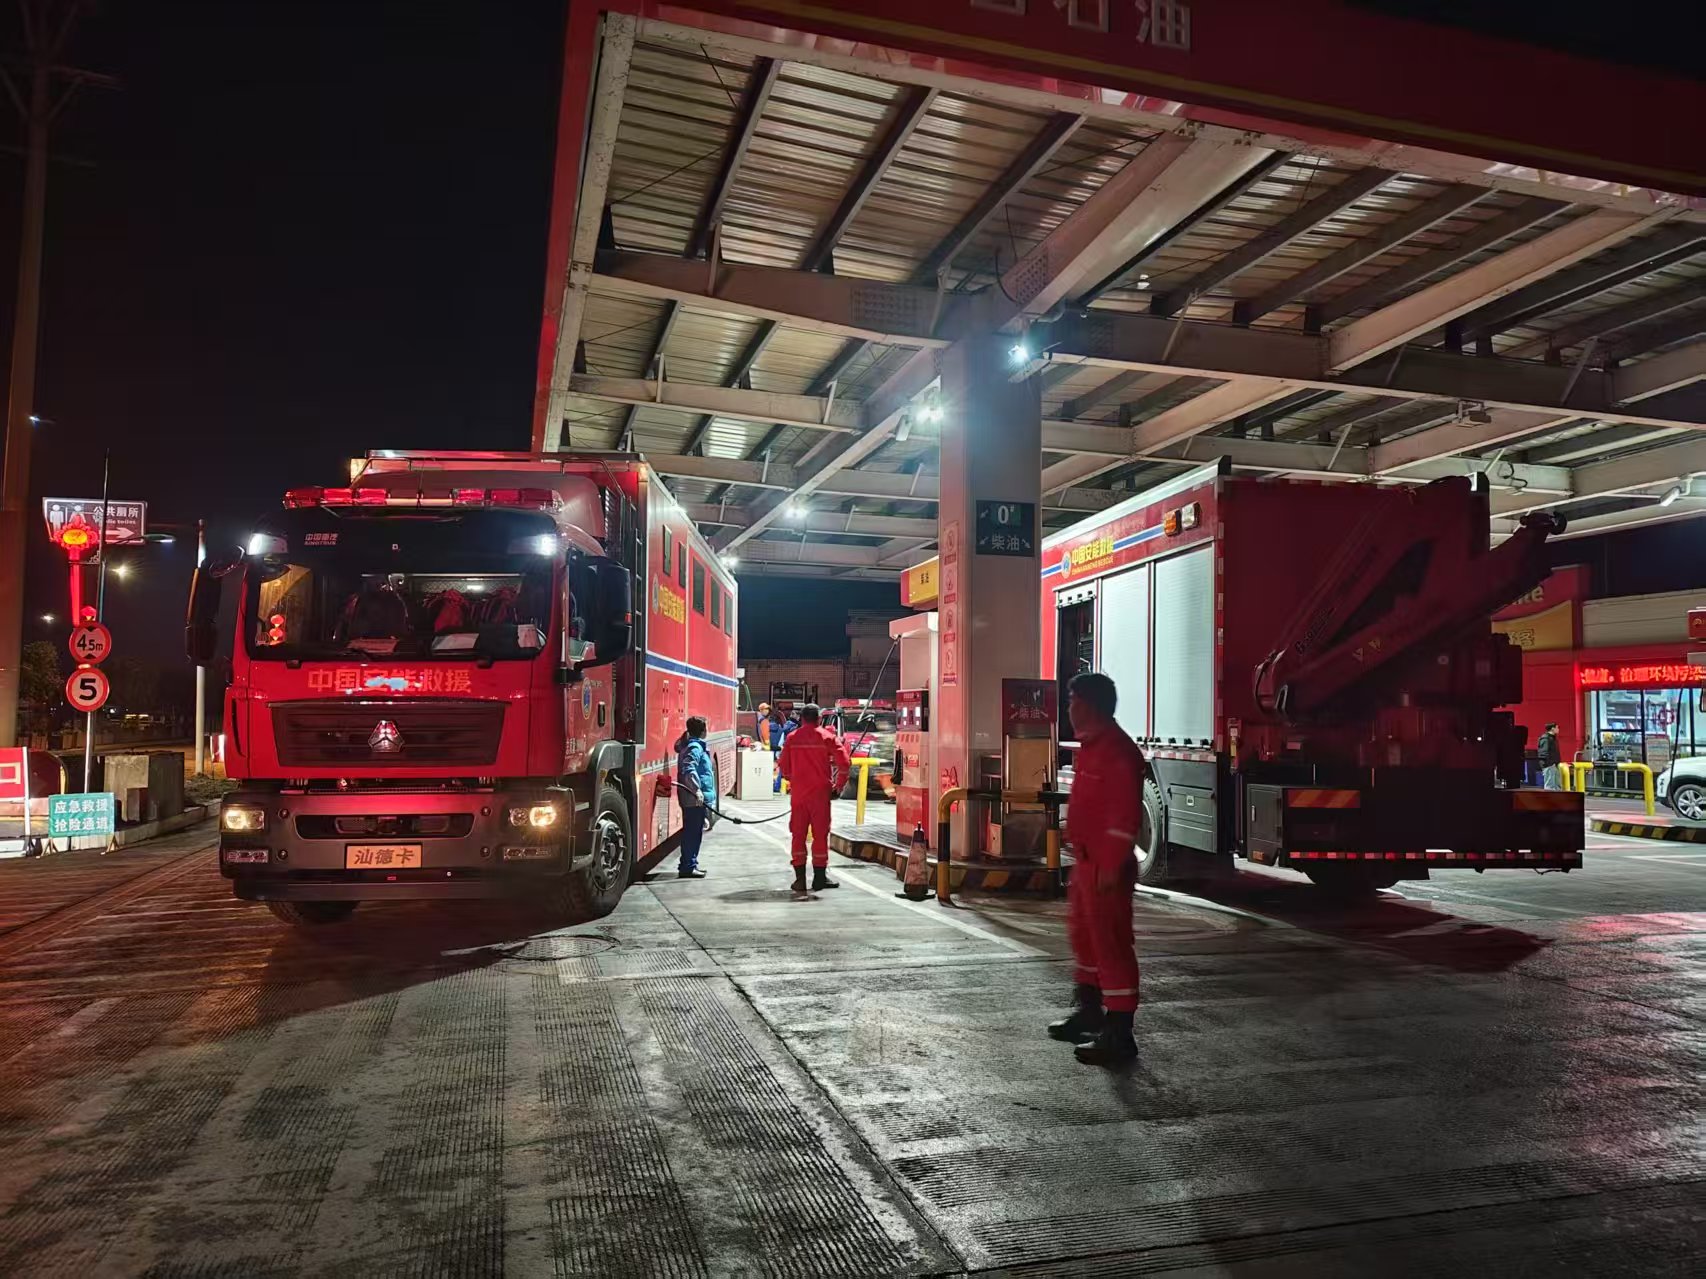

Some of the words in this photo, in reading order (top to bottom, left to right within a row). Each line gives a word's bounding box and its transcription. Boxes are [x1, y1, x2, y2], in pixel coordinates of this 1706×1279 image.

[992, 534, 1020, 551] 柴油
[79, 678, 97, 701] 5
[354, 848, 415, 865] 汕德卡
